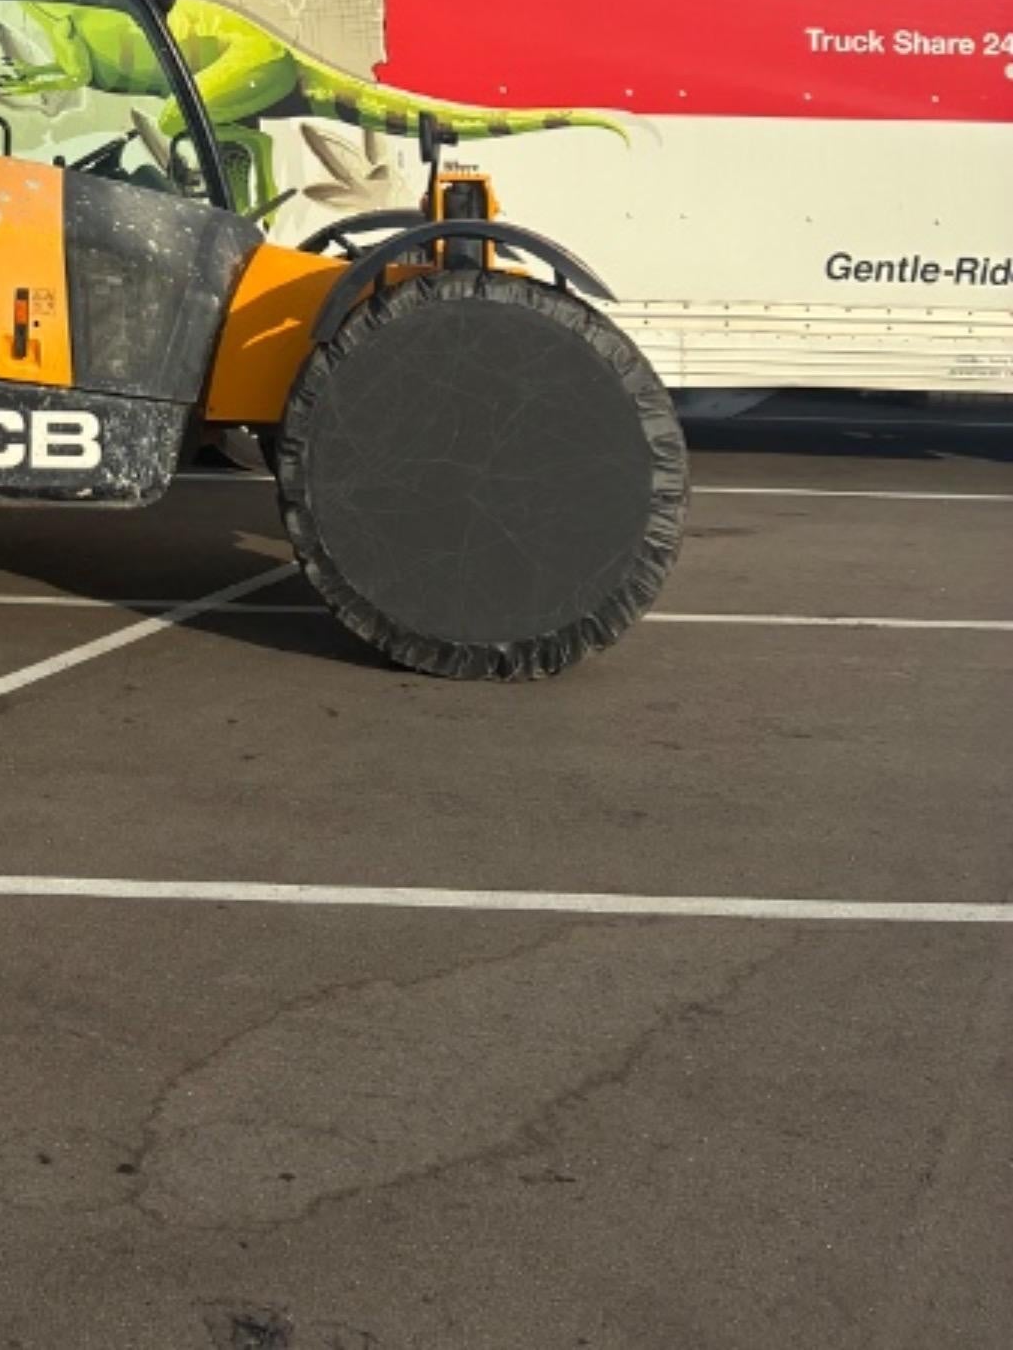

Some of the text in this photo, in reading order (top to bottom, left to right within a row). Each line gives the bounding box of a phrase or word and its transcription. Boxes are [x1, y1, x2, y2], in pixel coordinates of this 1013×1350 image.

[804, 27, 886, 53] Truck
[893, 30, 975, 55] Share
[825, 251, 1013, 286] Gentle-Rid
